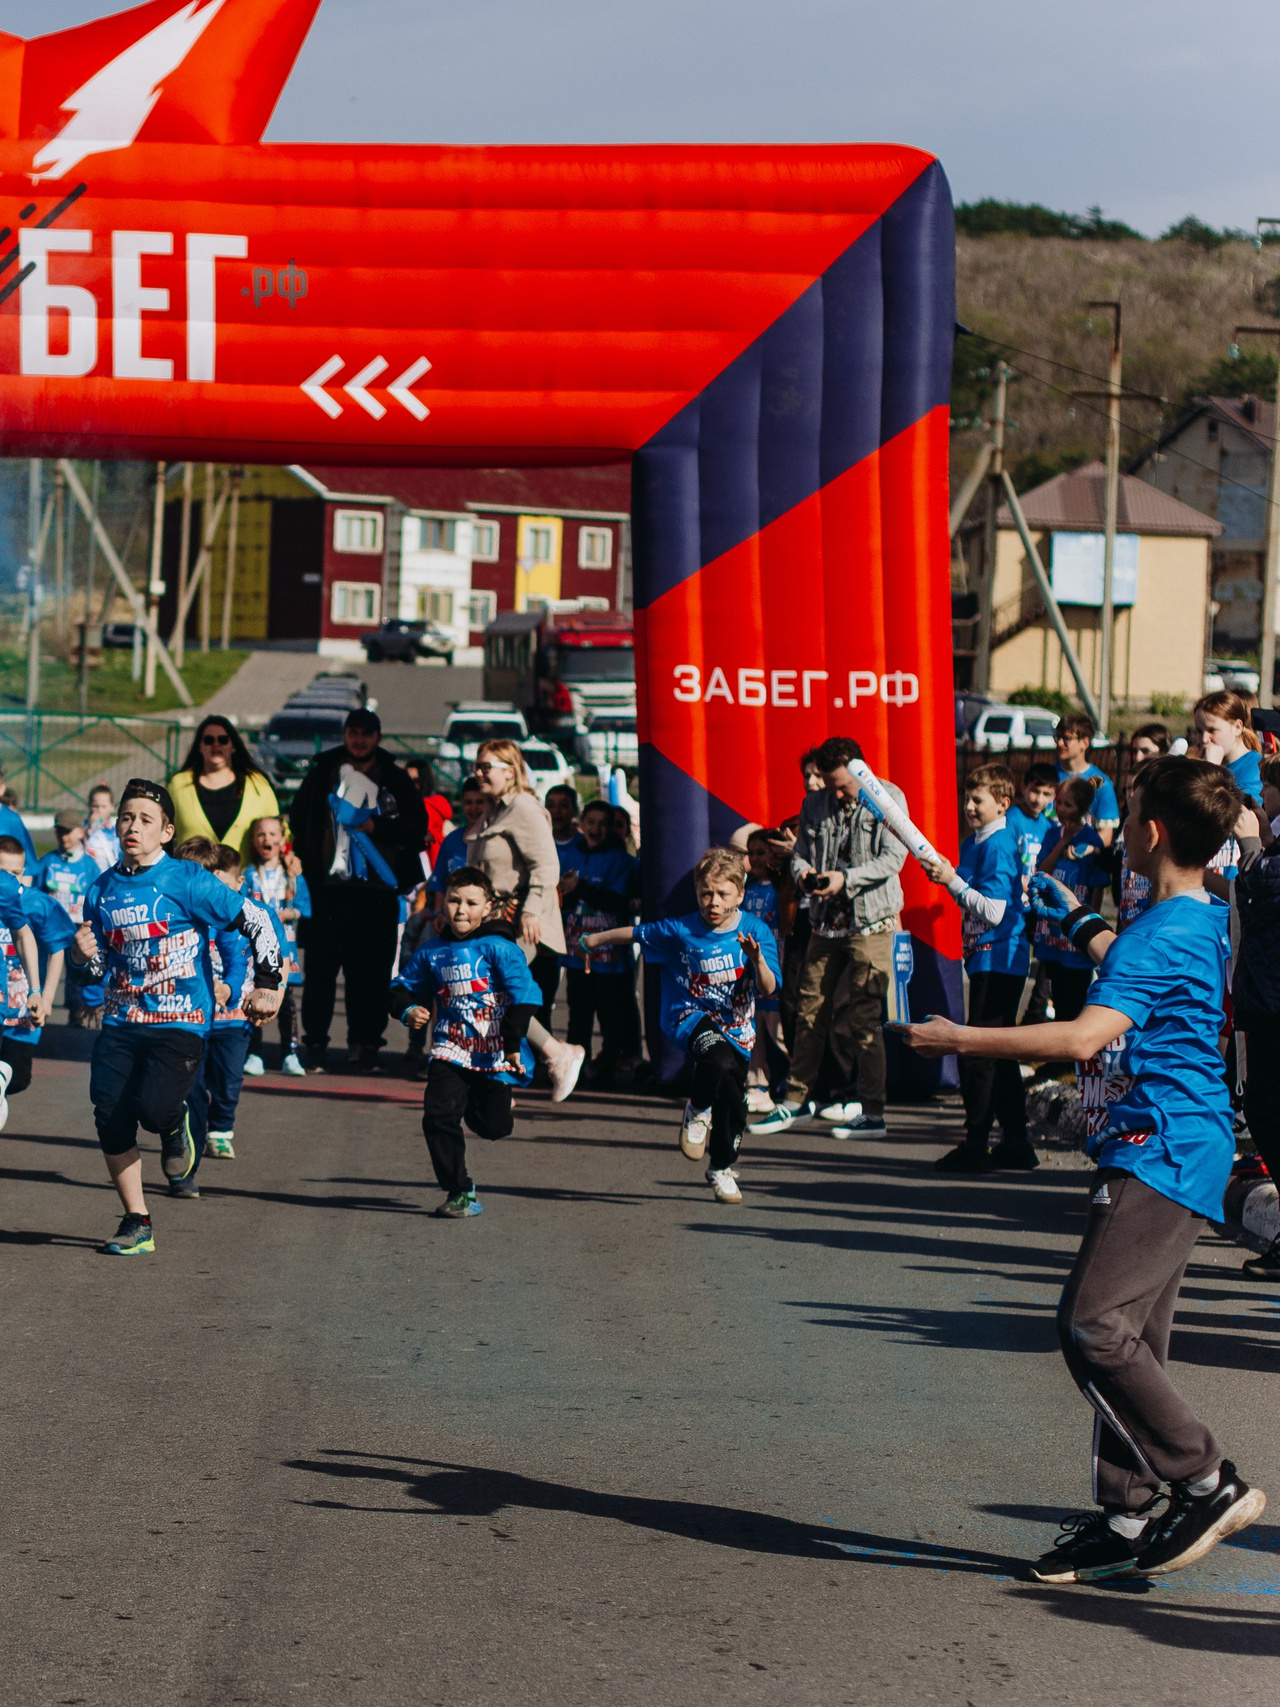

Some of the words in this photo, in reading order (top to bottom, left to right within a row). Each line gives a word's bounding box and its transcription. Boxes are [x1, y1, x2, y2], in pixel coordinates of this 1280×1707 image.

[673, 664, 920, 708] ЗАБЕГ.РФ
[111, 904, 150, 927] 00512
[441, 963, 473, 982] 00518
[699, 953, 735, 973] 00511
[157, 994, 193, 1013] 2024
